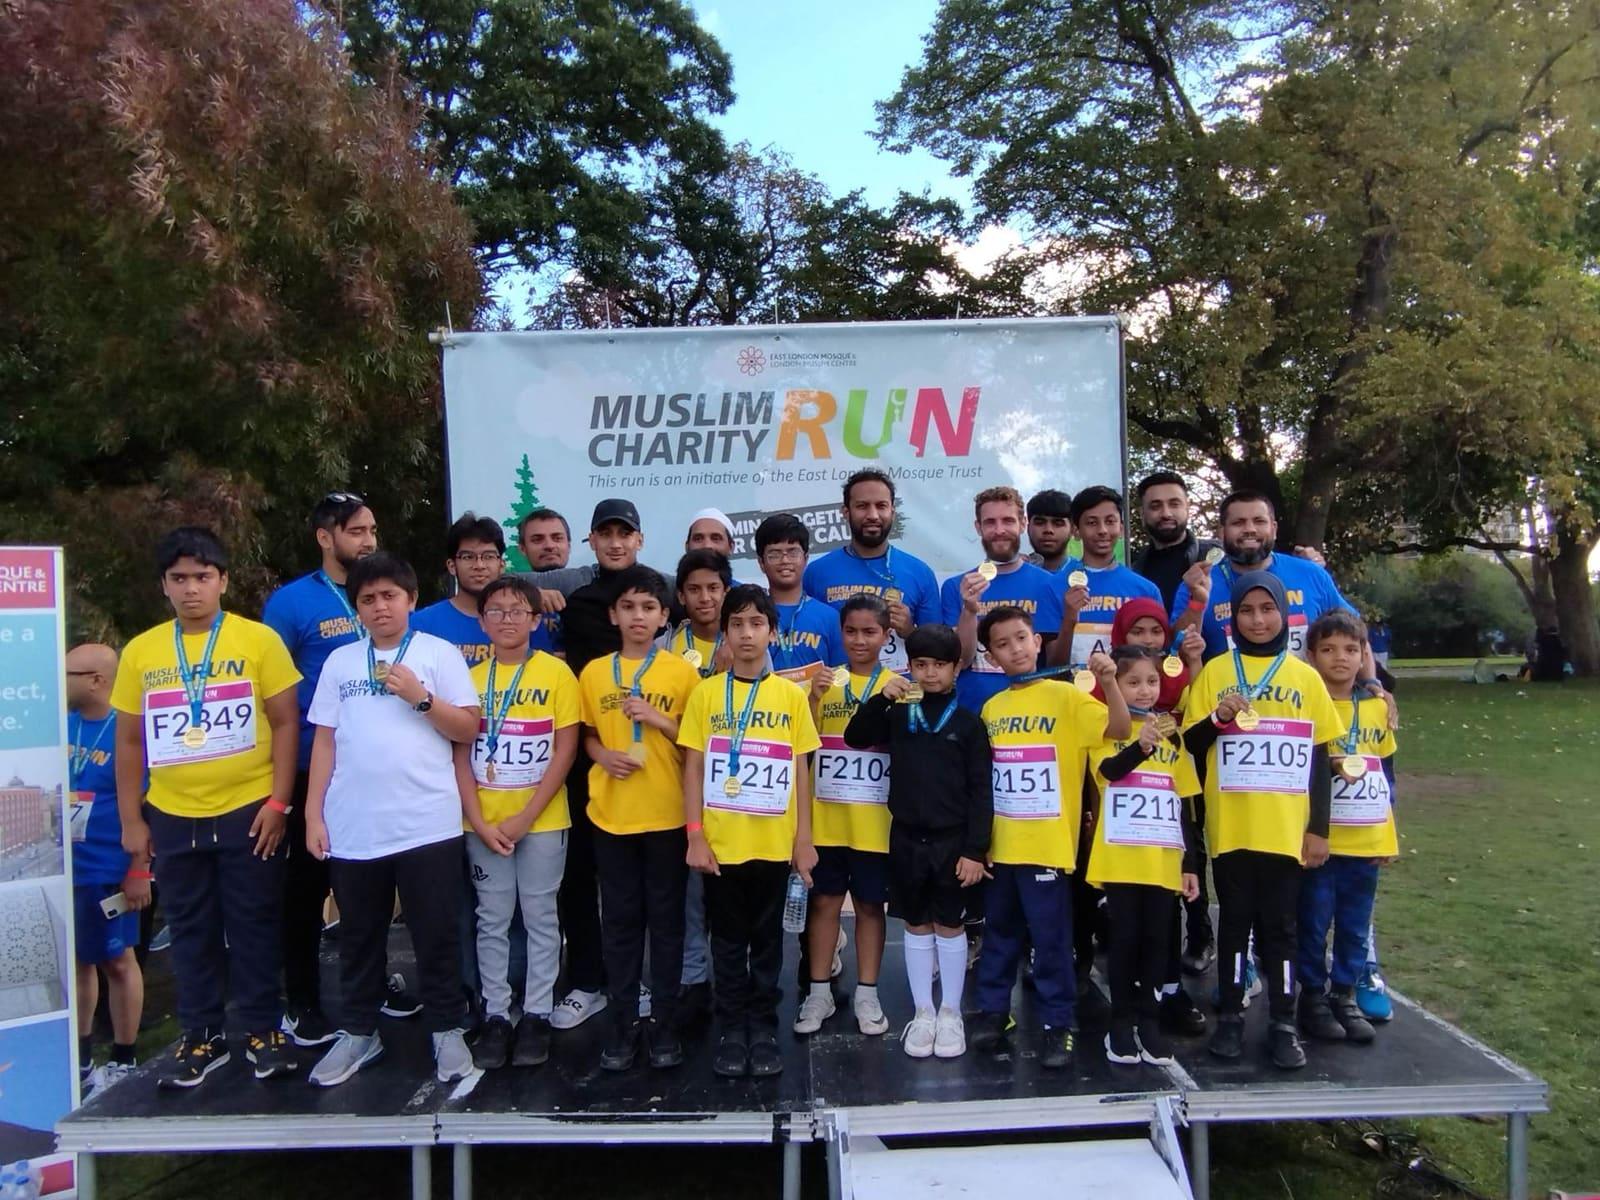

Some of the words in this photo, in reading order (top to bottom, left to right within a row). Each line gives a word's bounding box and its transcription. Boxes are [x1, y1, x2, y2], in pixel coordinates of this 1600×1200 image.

[769, 360, 801, 368] LONDON
[787, 352, 819, 360] LONDON
[820, 352, 851, 360] MOSQUE
[590, 391, 775, 430] MUSLIM
[776, 387, 981, 461] RUN
[588, 429, 770, 467] CHARITY
[588, 474, 617, 489] This
[620, 475, 646, 487] run
[649, 473, 661, 486] is
[664, 474, 683, 486] an
[686, 470, 749, 485] initiative
[752, 468, 768, 486] of
[771, 469, 794, 482] the
[797, 469, 827, 482] East
[887, 466, 944, 480] Mosque
[948, 464, 983, 478] Trust
[815, 525, 852, 544] CAU
[21, 628, 35, 641] a
[751, 710, 793, 731] RUN
[1008, 715, 1057, 735] RUN
[1222, 740, 1309, 769] F2105
[711, 758, 790, 791] F214
